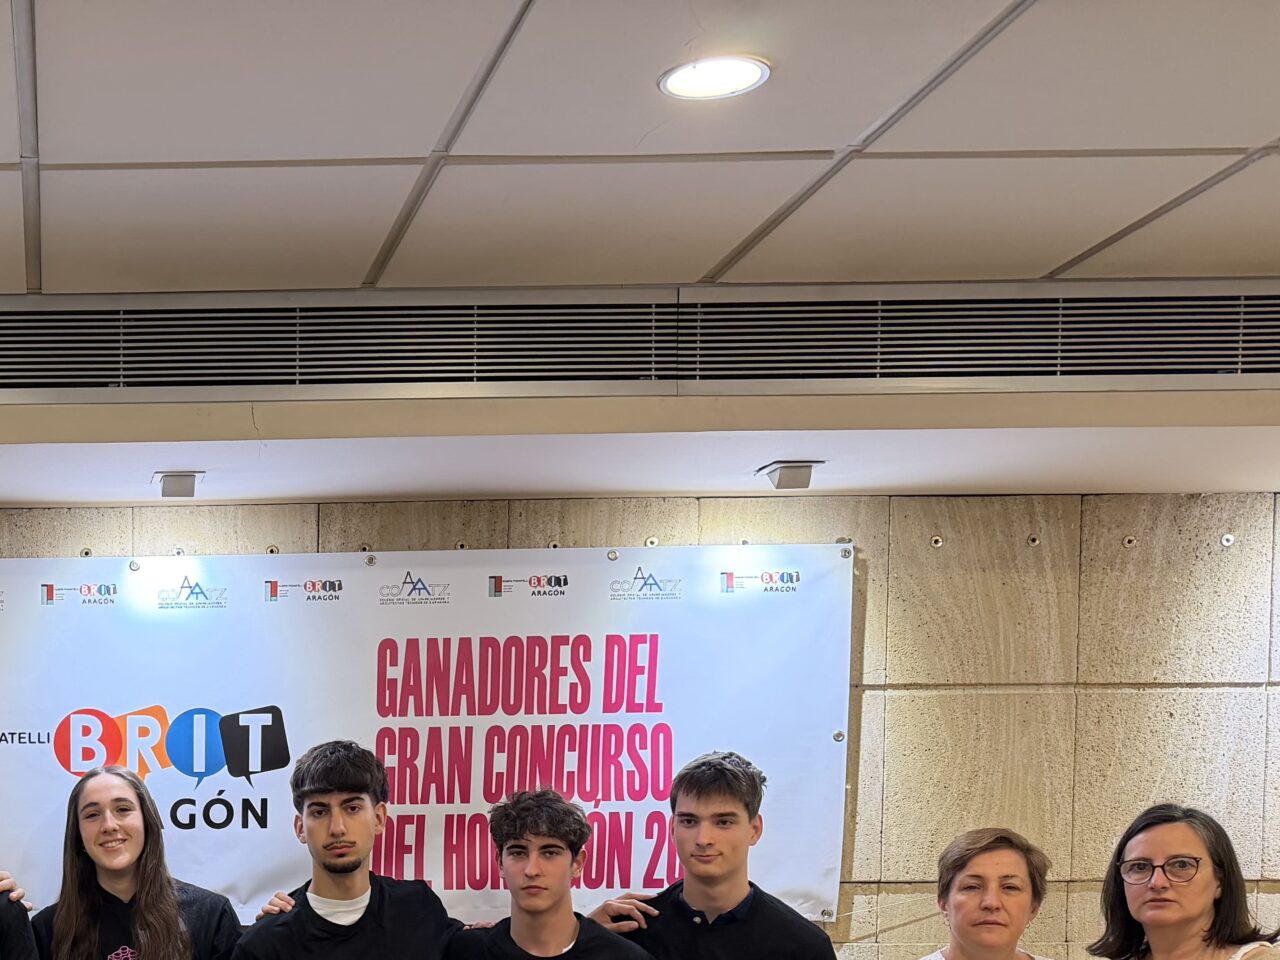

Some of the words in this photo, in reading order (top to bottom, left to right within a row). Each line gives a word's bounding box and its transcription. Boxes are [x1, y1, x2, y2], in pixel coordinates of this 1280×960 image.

[80, 584, 117, 597] BRIT
[304, 580, 342, 592] BRIT
[530, 575, 567, 588] BRIT
[376, 634, 592, 718] GANADORES
[602, 633, 663, 714] DEL
[70, 713, 273, 773] BRIT
[376, 726, 473, 805] GRAN
[482, 722, 674, 804] CONCURSO
